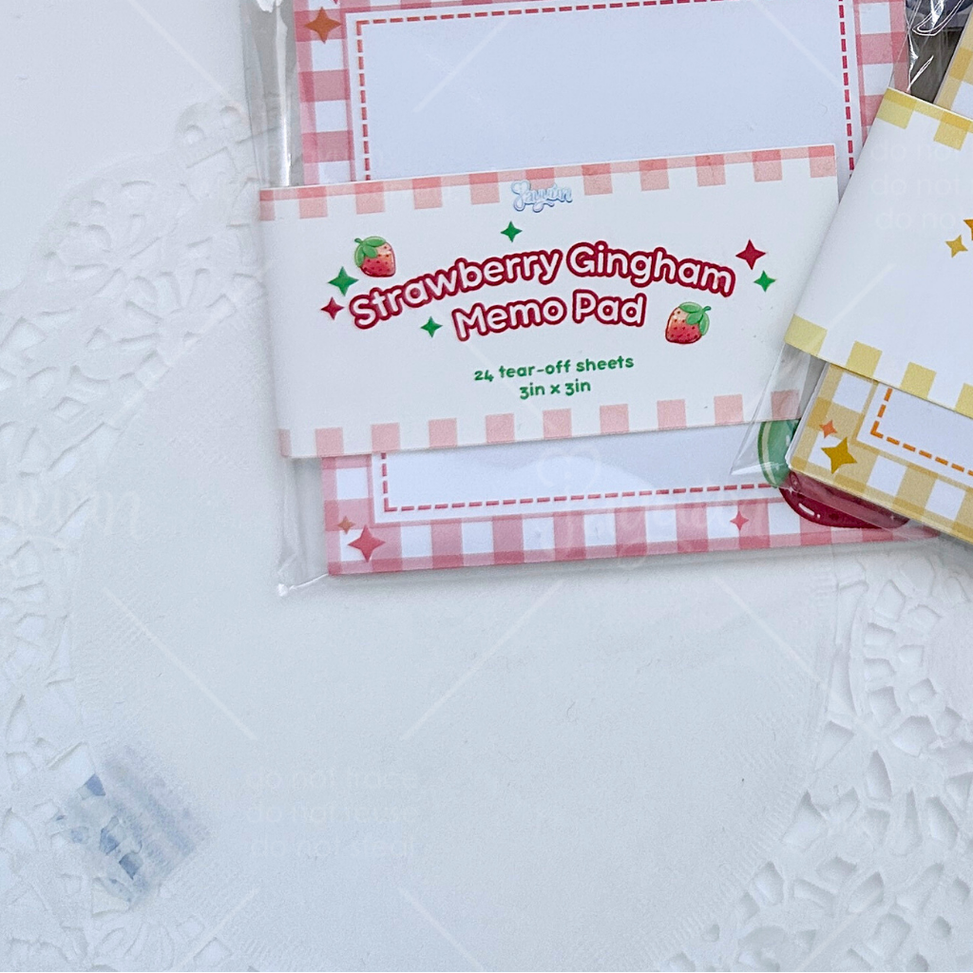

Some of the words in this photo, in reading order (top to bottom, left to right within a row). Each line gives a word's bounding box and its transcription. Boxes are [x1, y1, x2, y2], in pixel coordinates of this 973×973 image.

[349, 248, 564, 330] Strawberry
[566, 240, 737, 299] Gingham
[451, 295, 566, 342] Memo
[572, 288, 648, 329] Pad
[473, 367, 495, 381] 24
[498, 359, 572, 378] tear-off
[575, 355, 635, 374] sheets
[519, 381, 546, 400] 3in
[550, 383, 562, 395] x
[564, 378, 592, 397] 3in
